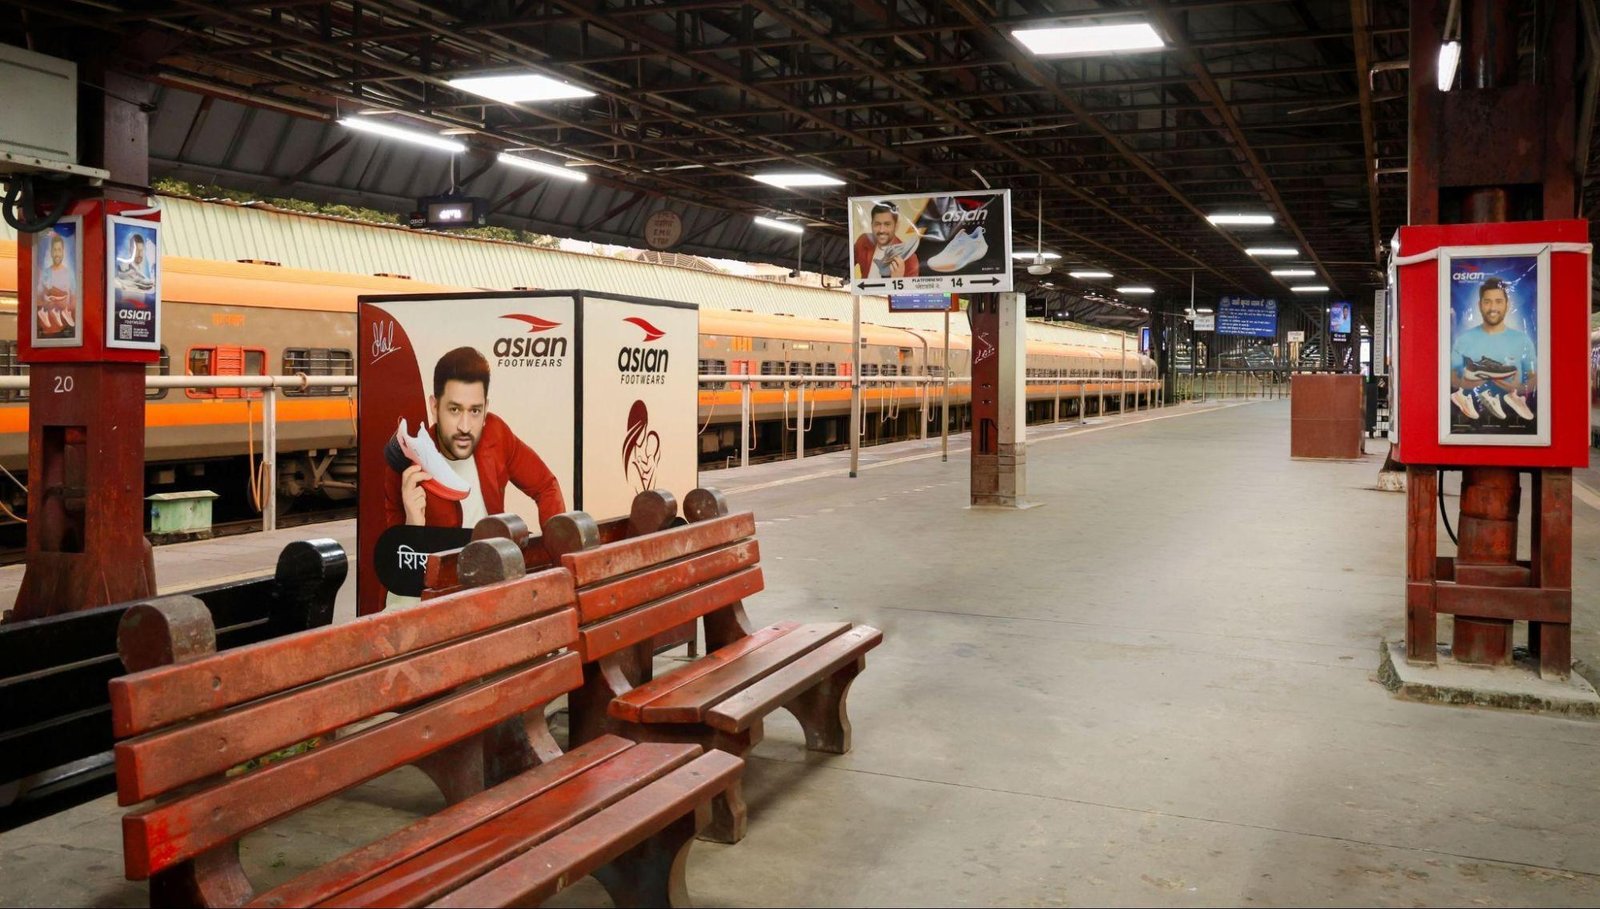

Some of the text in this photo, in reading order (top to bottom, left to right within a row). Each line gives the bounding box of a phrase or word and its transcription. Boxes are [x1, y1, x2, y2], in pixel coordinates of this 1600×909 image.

[942, 209, 988, 222] asian
[1452, 272, 1485, 280] asian
[892, 280, 904, 290] 15
[951, 278, 963, 288] 14
[119, 309, 151, 320] asian
[493, 337, 567, 357] asian
[498, 359, 562, 367] FOOTWEARS
[618, 346, 669, 373] asian
[54, 376, 74, 393] 20
[620, 374, 666, 385] FOOTWEARS
